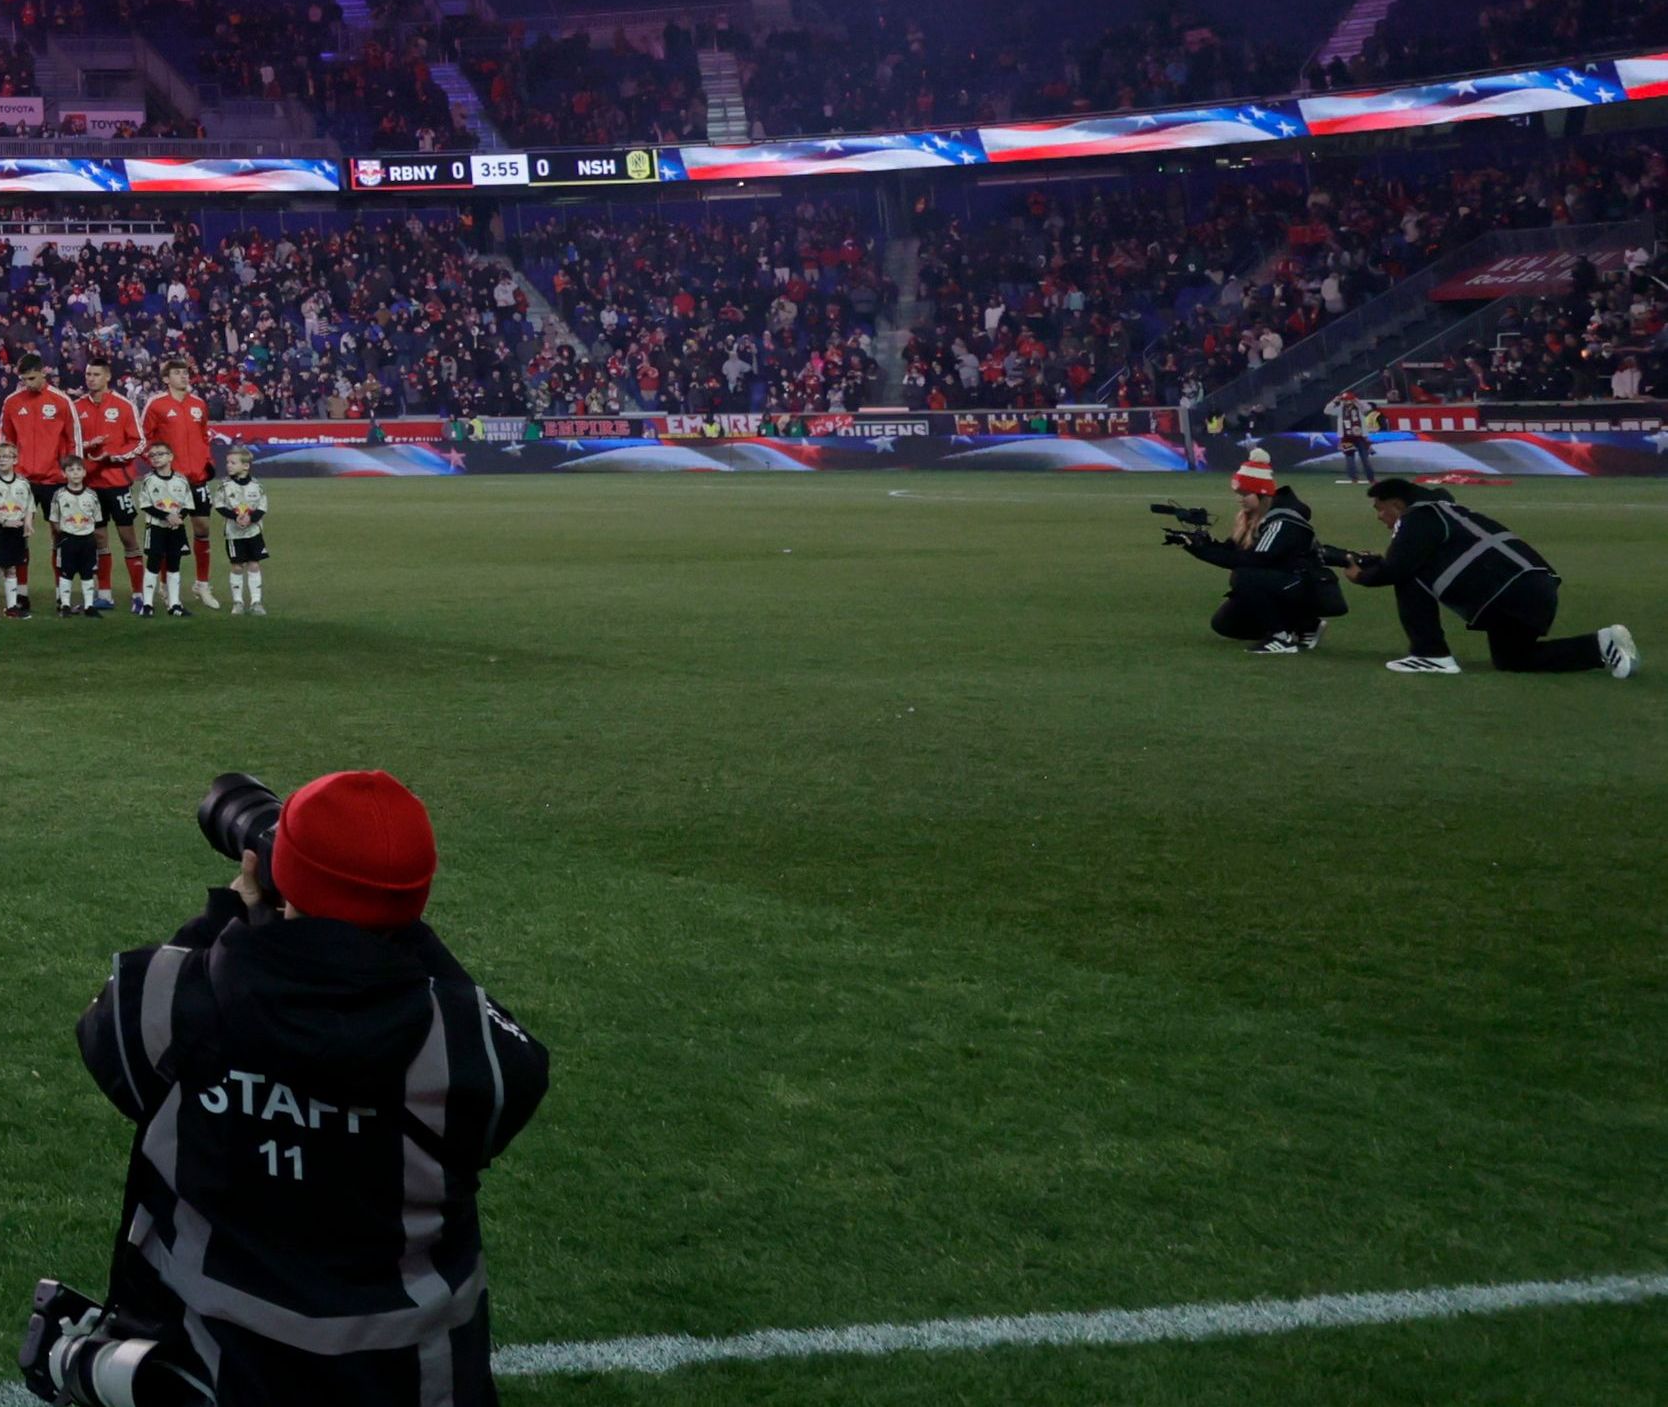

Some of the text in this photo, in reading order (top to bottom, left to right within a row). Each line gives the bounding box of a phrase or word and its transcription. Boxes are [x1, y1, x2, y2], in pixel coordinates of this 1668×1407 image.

[0, 104, 35, 113] TOYOTA
[389, 159, 615, 181] RBNY 0 3:55 0 NSH
[544, 420, 631, 437] EMPIRE
[665, 414, 763, 436] EMIRE
[258, 1139, 304, 1181] 11
